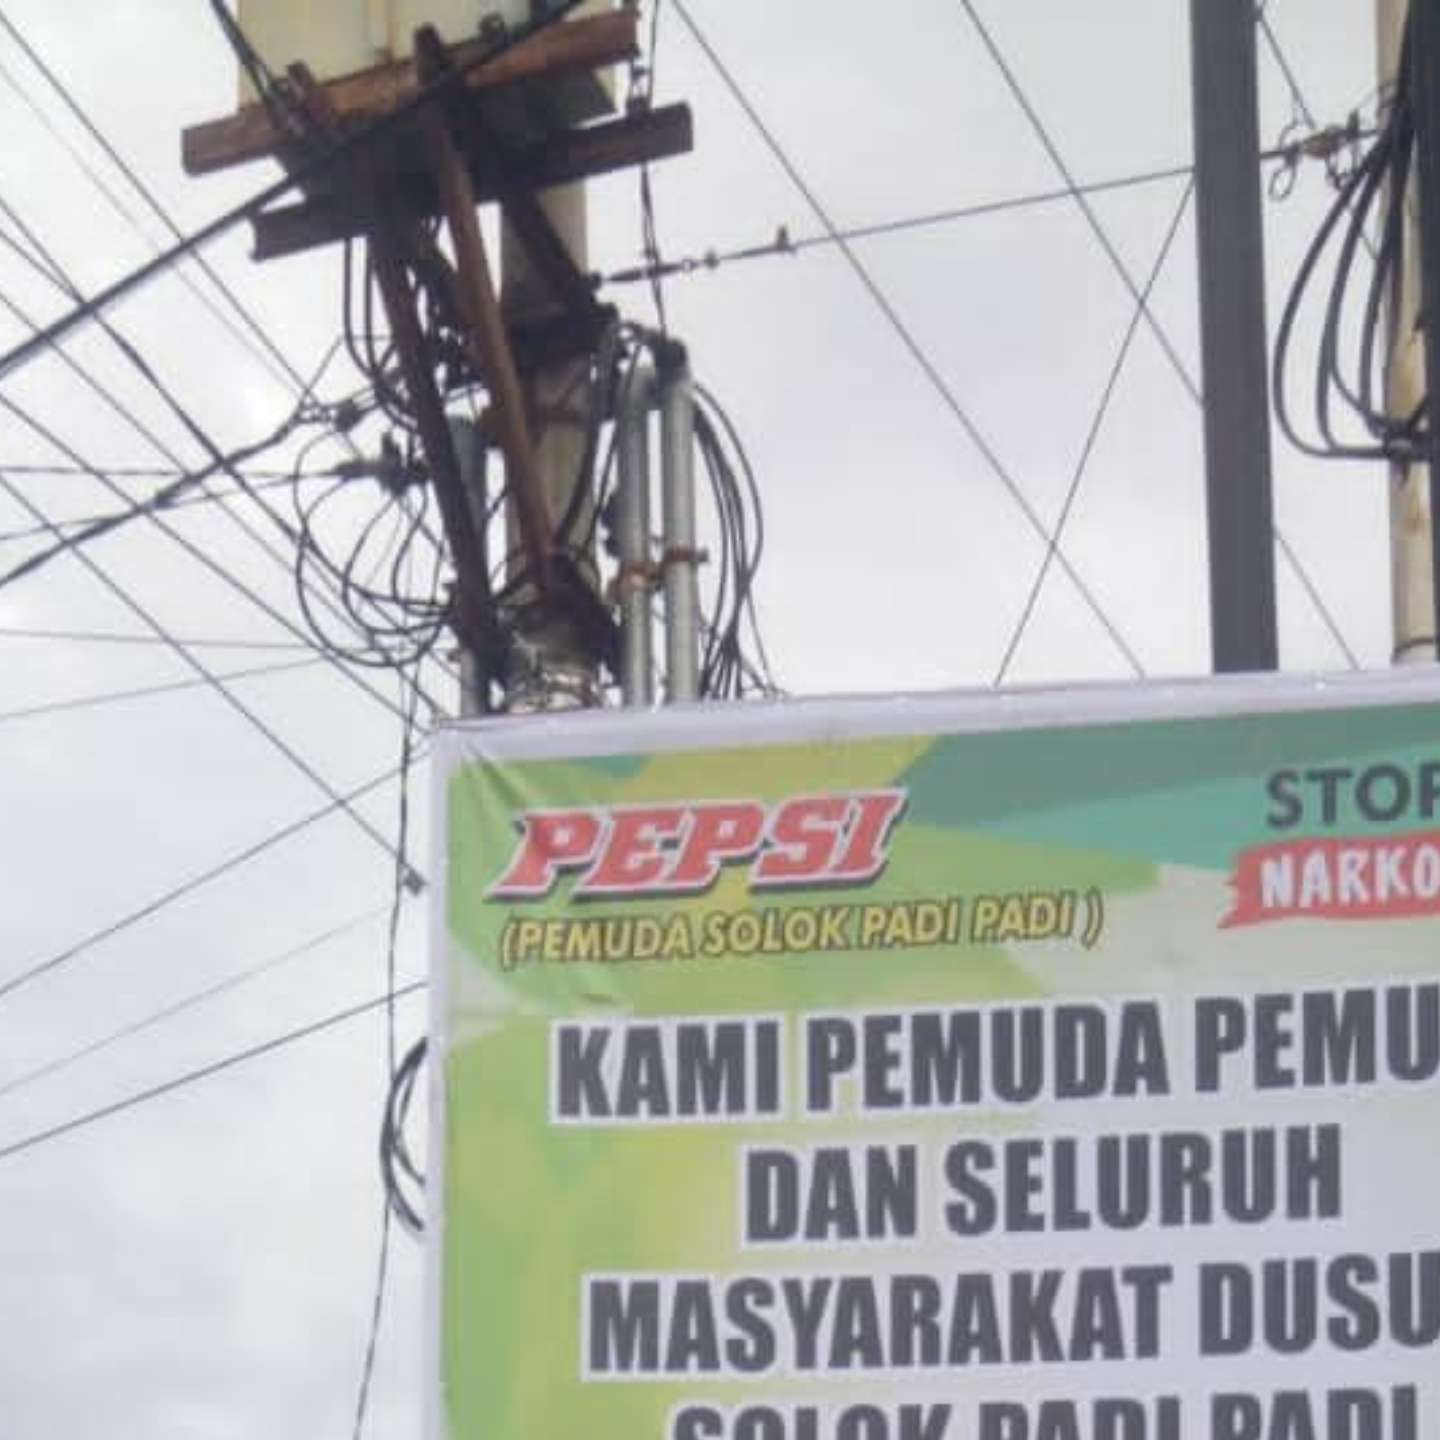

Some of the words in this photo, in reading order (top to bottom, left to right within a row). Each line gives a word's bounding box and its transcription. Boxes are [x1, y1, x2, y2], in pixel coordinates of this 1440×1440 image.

[486, 788, 908, 900] PEPSI
[501, 908, 692, 969] (PEMUDA
[702, 905, 850, 958] SOLOK
[862, 899, 961, 948] PADI
[556, 1018, 778, 1119] KAMI
[806, 1002, 1170, 1112] PEMUDA
[745, 1144, 917, 1244] DAN
[945, 1124, 1342, 1238] SELURUH
[588, 1266, 1173, 1374] MASYARAKAT
